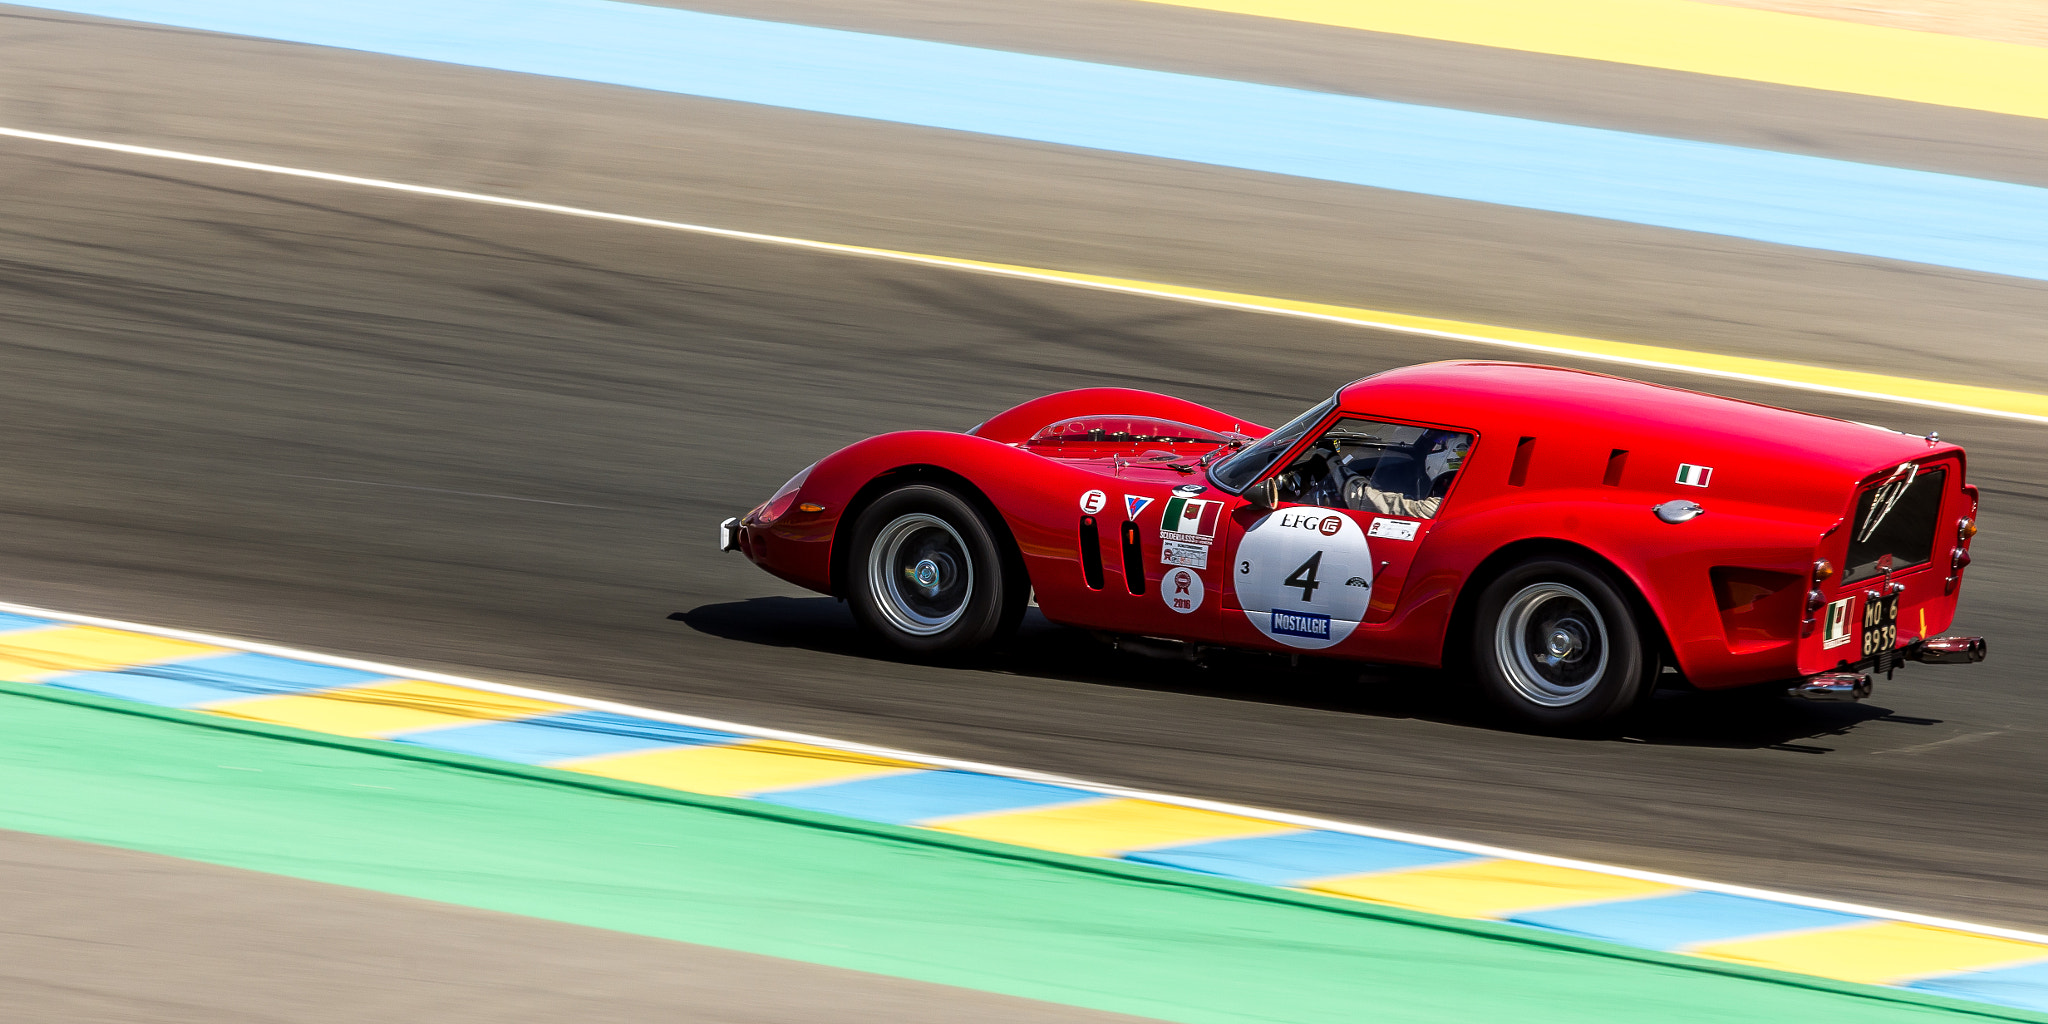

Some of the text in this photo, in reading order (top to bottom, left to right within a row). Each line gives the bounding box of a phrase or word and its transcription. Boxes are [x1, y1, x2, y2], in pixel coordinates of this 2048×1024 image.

[1085, 493, 1102, 510] E
[1280, 513, 1319, 531] EFG
[1240, 561, 1250, 574] 3
[1283, 550, 1323, 602] 4
[1173, 598, 1191, 609] 2016
[1864, 598, 1898, 628] MO 6
[1274, 613, 1328, 635] NOSTALGIE
[1863, 624, 1897, 655] 8939
